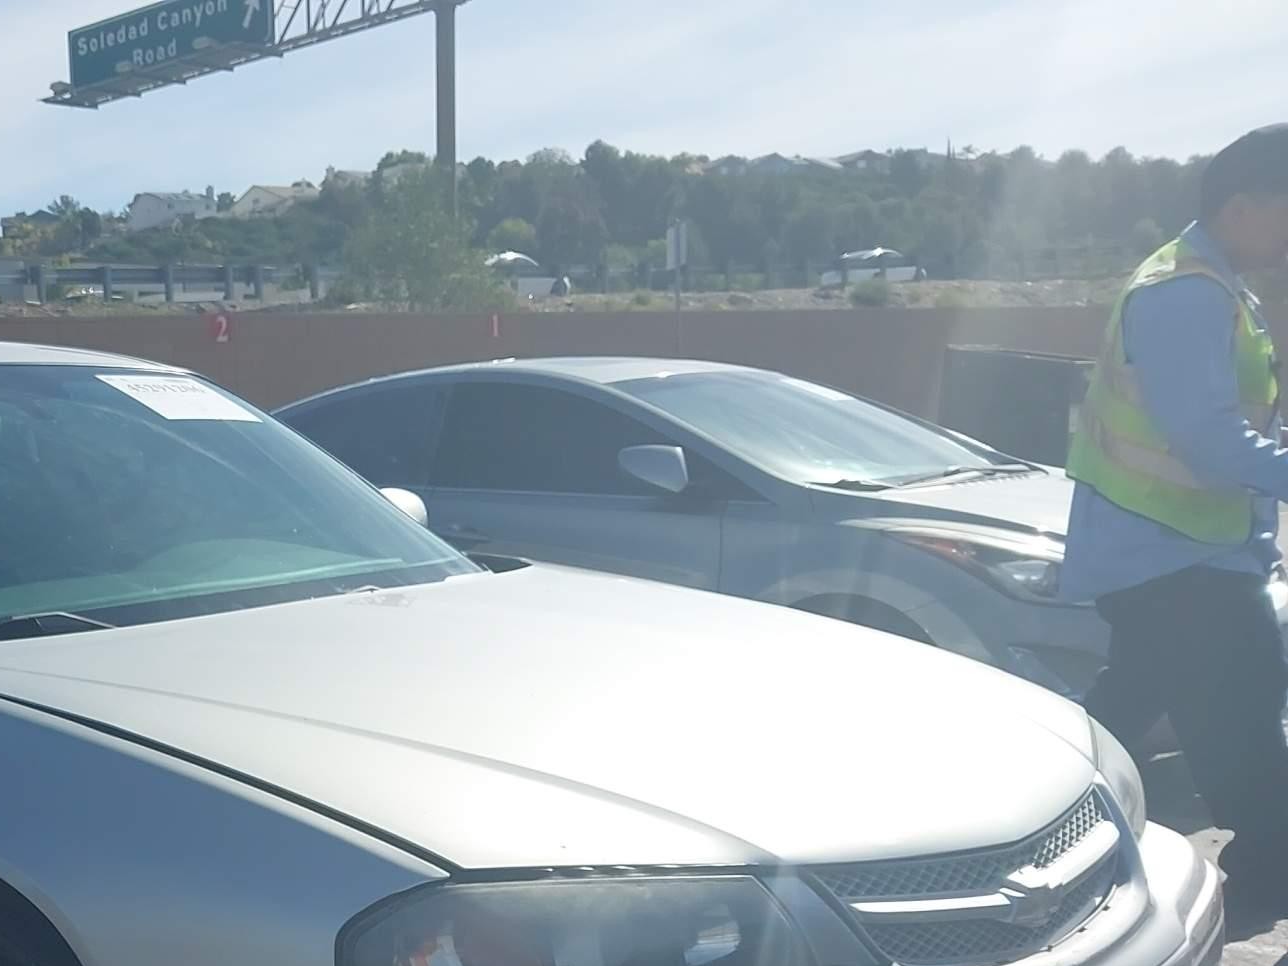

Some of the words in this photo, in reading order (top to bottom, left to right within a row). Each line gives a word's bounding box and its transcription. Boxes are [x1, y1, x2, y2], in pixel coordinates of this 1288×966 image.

[77, 17, 148, 56] Soledad
[157, 0, 227, 30] Canyon
[133, 37, 177, 65] Road
[216, 315, 228, 342] 2
